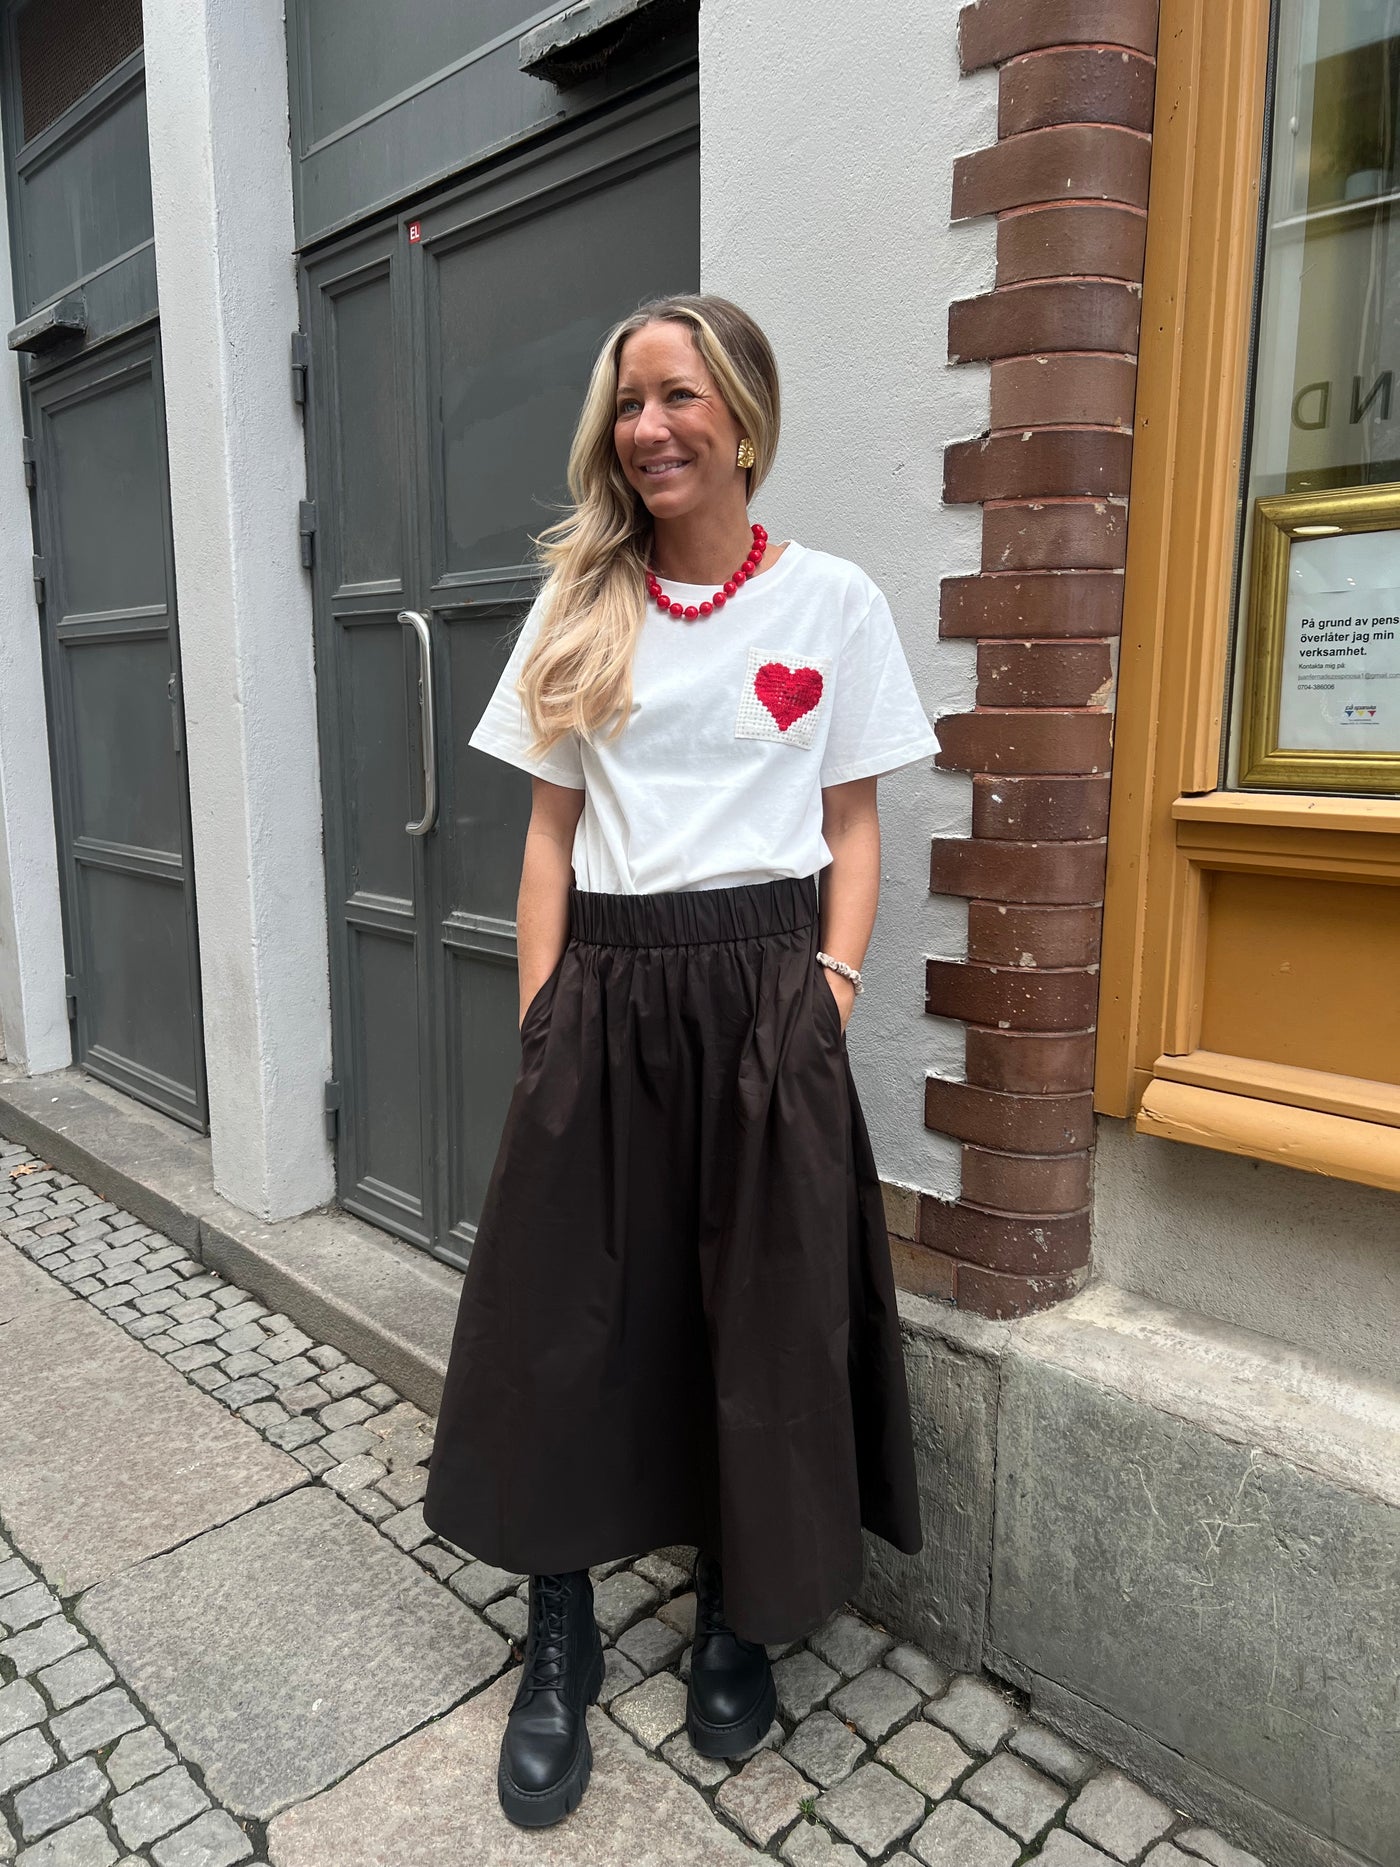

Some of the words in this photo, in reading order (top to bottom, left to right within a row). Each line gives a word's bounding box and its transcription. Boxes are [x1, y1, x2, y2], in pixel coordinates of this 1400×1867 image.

[410, 225, 420, 240] EL
[1301, 618, 1315, 628] På
[1318, 617, 1352, 630] grund
[1355, 618, 1368, 626] av
[1371, 616, 1400, 627] pens
[1300, 631, 1350, 643] överlåter
[1351, 631, 1370, 643] jag
[1373, 630, 1394, 640] min
[1299, 647, 1367, 657] verksamhet.
